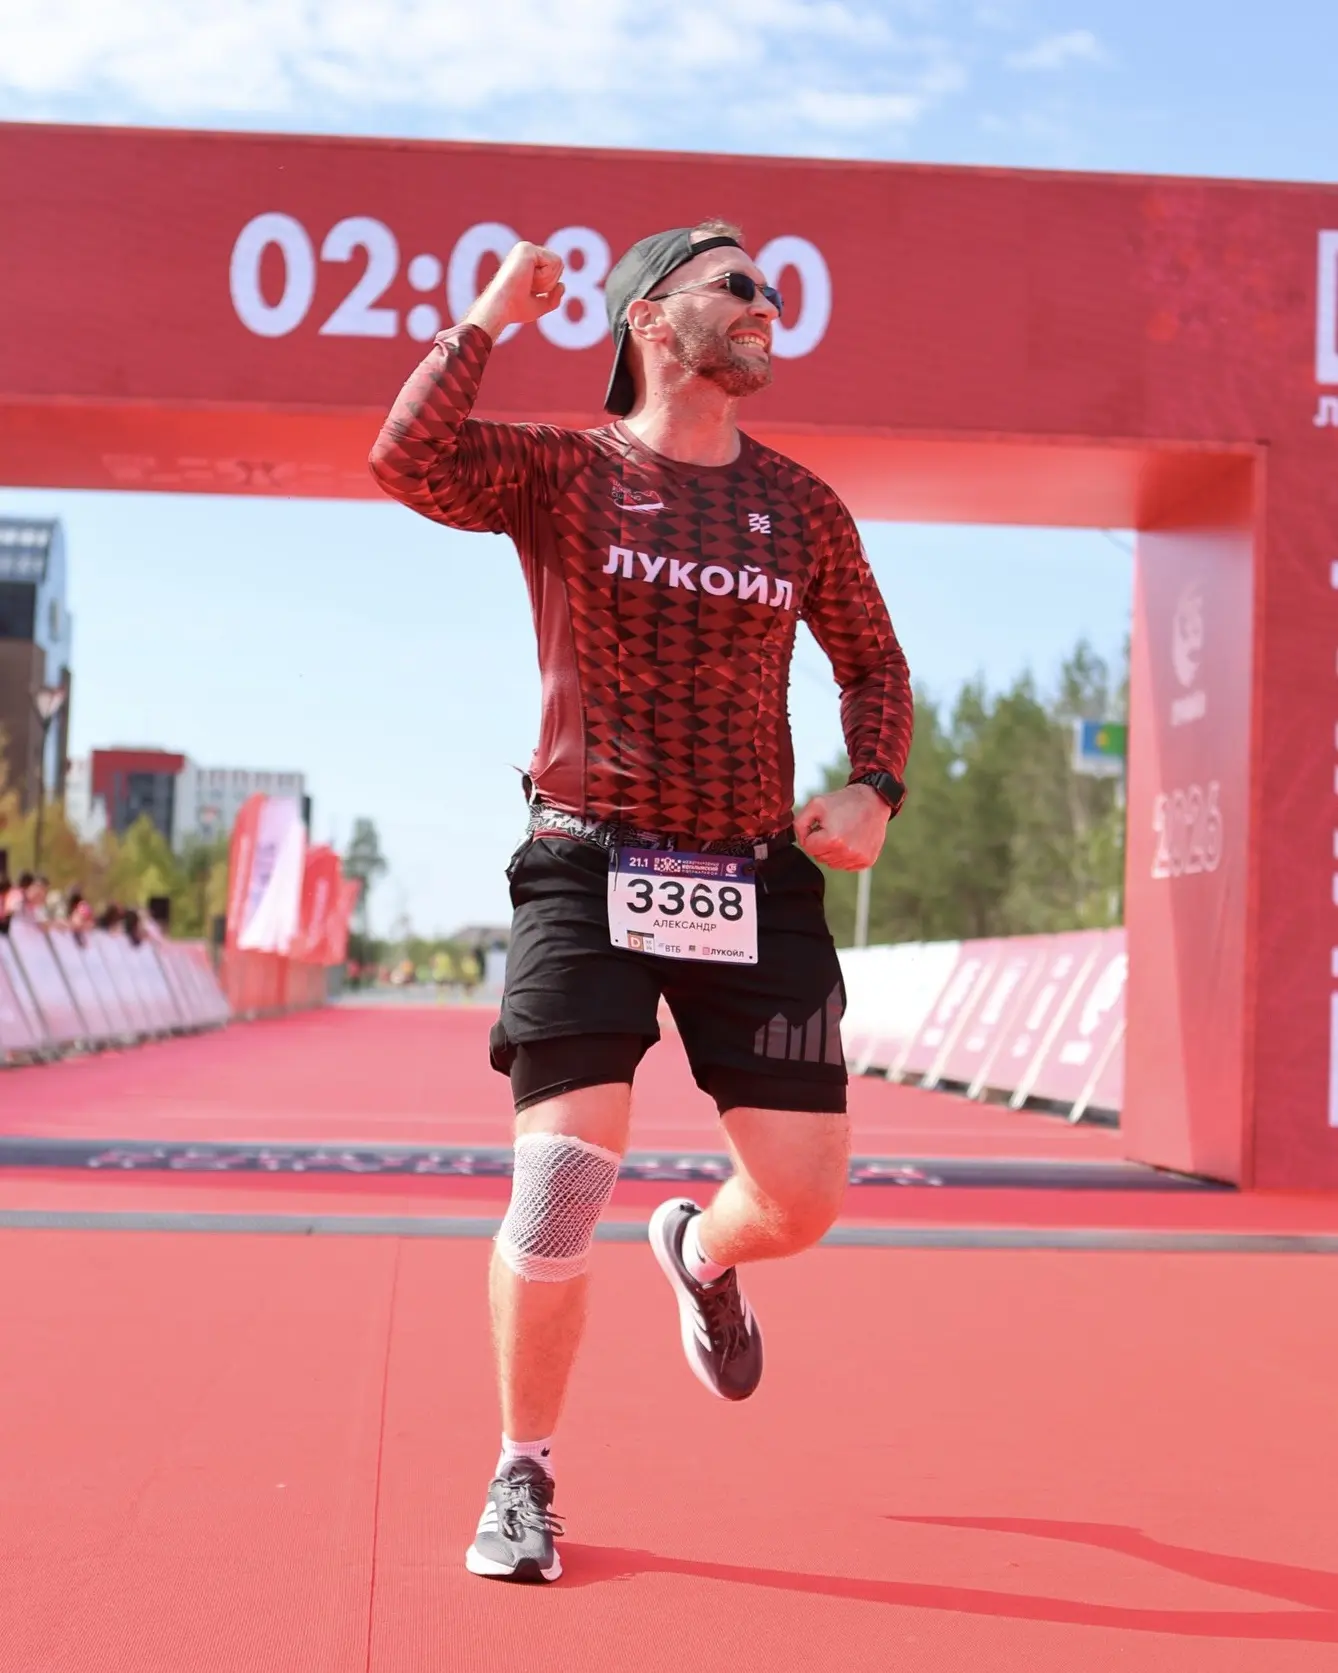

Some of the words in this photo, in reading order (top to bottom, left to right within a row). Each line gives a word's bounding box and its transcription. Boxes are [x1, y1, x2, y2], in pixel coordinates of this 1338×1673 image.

[602, 545, 793, 611] ЛУКОЙЛ
[629, 857, 648, 868] 21.1
[626, 878, 744, 922] 3368
[653, 919, 717, 932] АЛЕКСАНДР
[665, 944, 681, 953] ВТБ
[711, 949, 744, 958] ЛУКОЙЛ
